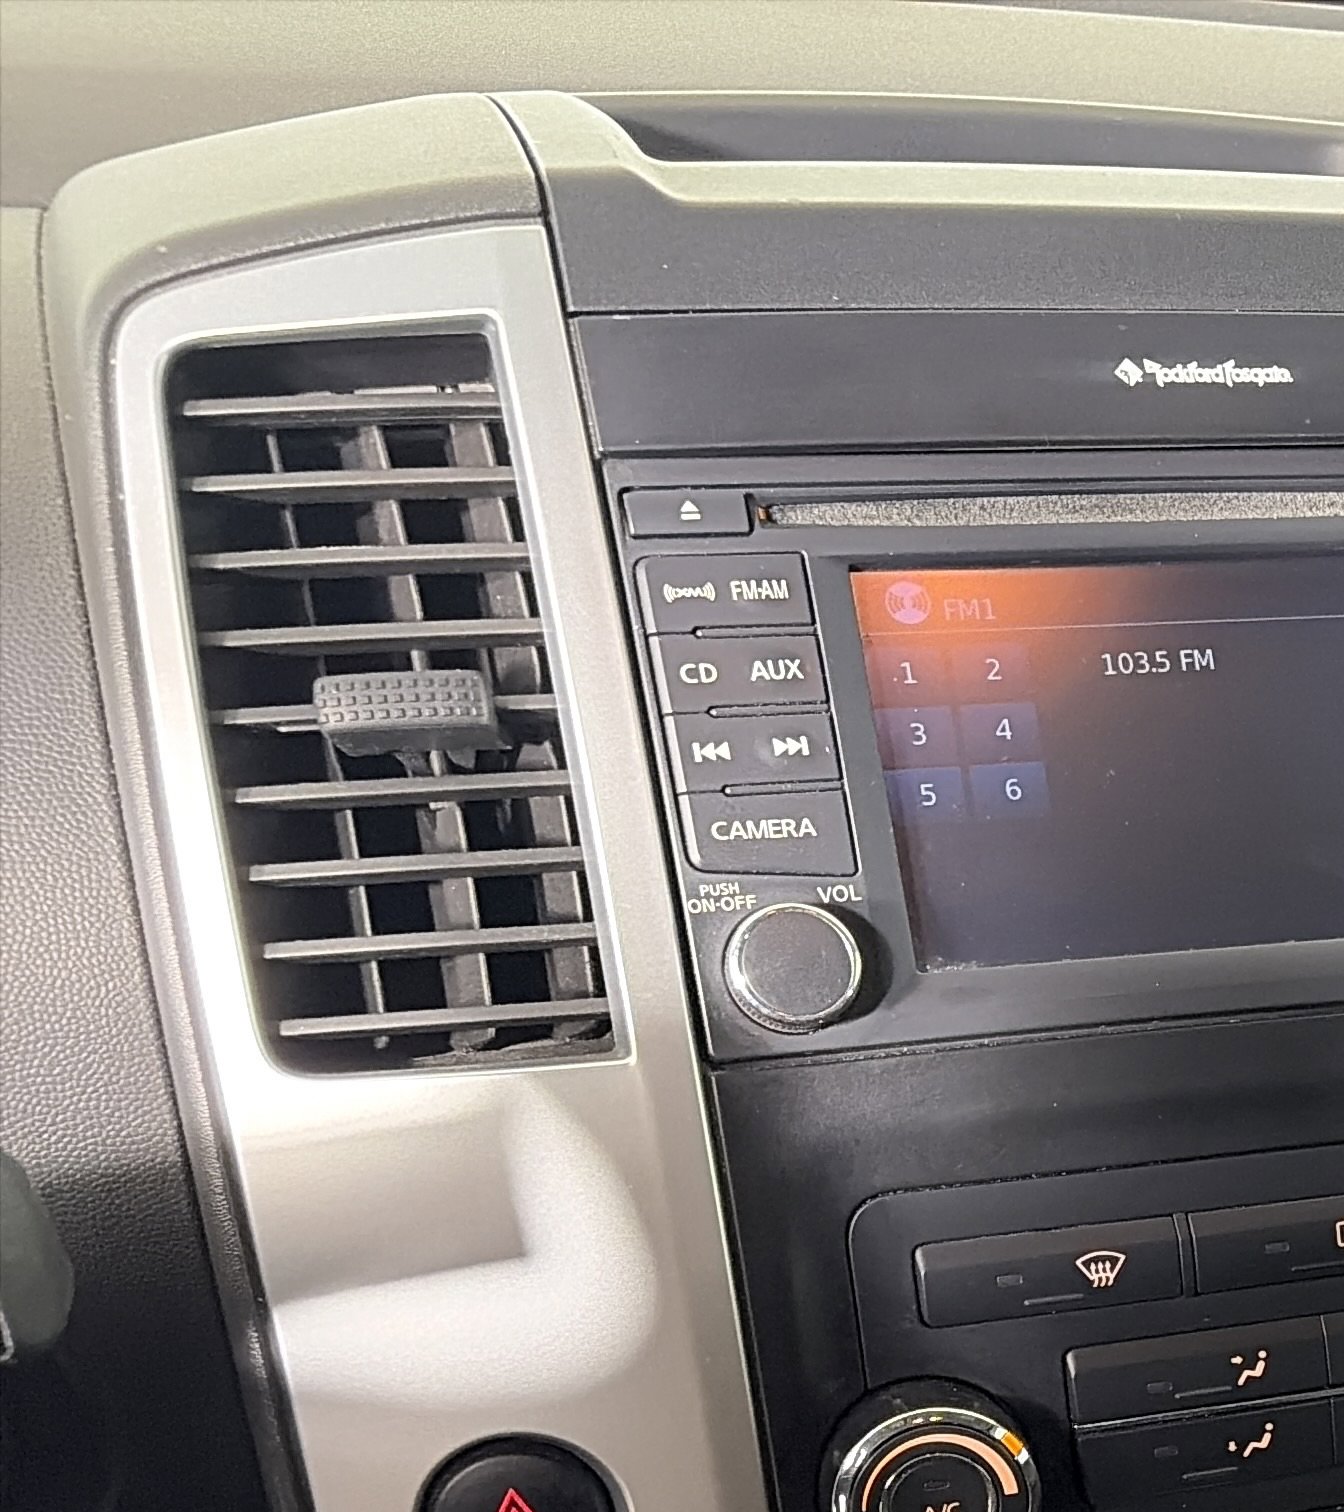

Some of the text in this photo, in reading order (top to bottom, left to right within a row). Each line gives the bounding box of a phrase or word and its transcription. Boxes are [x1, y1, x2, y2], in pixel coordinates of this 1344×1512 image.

[943, 598, 997, 622] FM1
[679, 663, 718, 684] CD
[750, 658, 805, 682] AUX
[901, 661, 919, 685] 1
[985, 658, 1002, 682] 2
[1101, 648, 1216, 676] 103.5 FM
[909, 722, 928, 746] 3
[995, 717, 1013, 741] 4
[919, 782, 937, 807] 5
[1004, 777, 1023, 801] 6
[710, 817, 818, 841] CAMERA
[699, 882, 741, 897] PUSH
[816, 885, 863, 904] VOL
